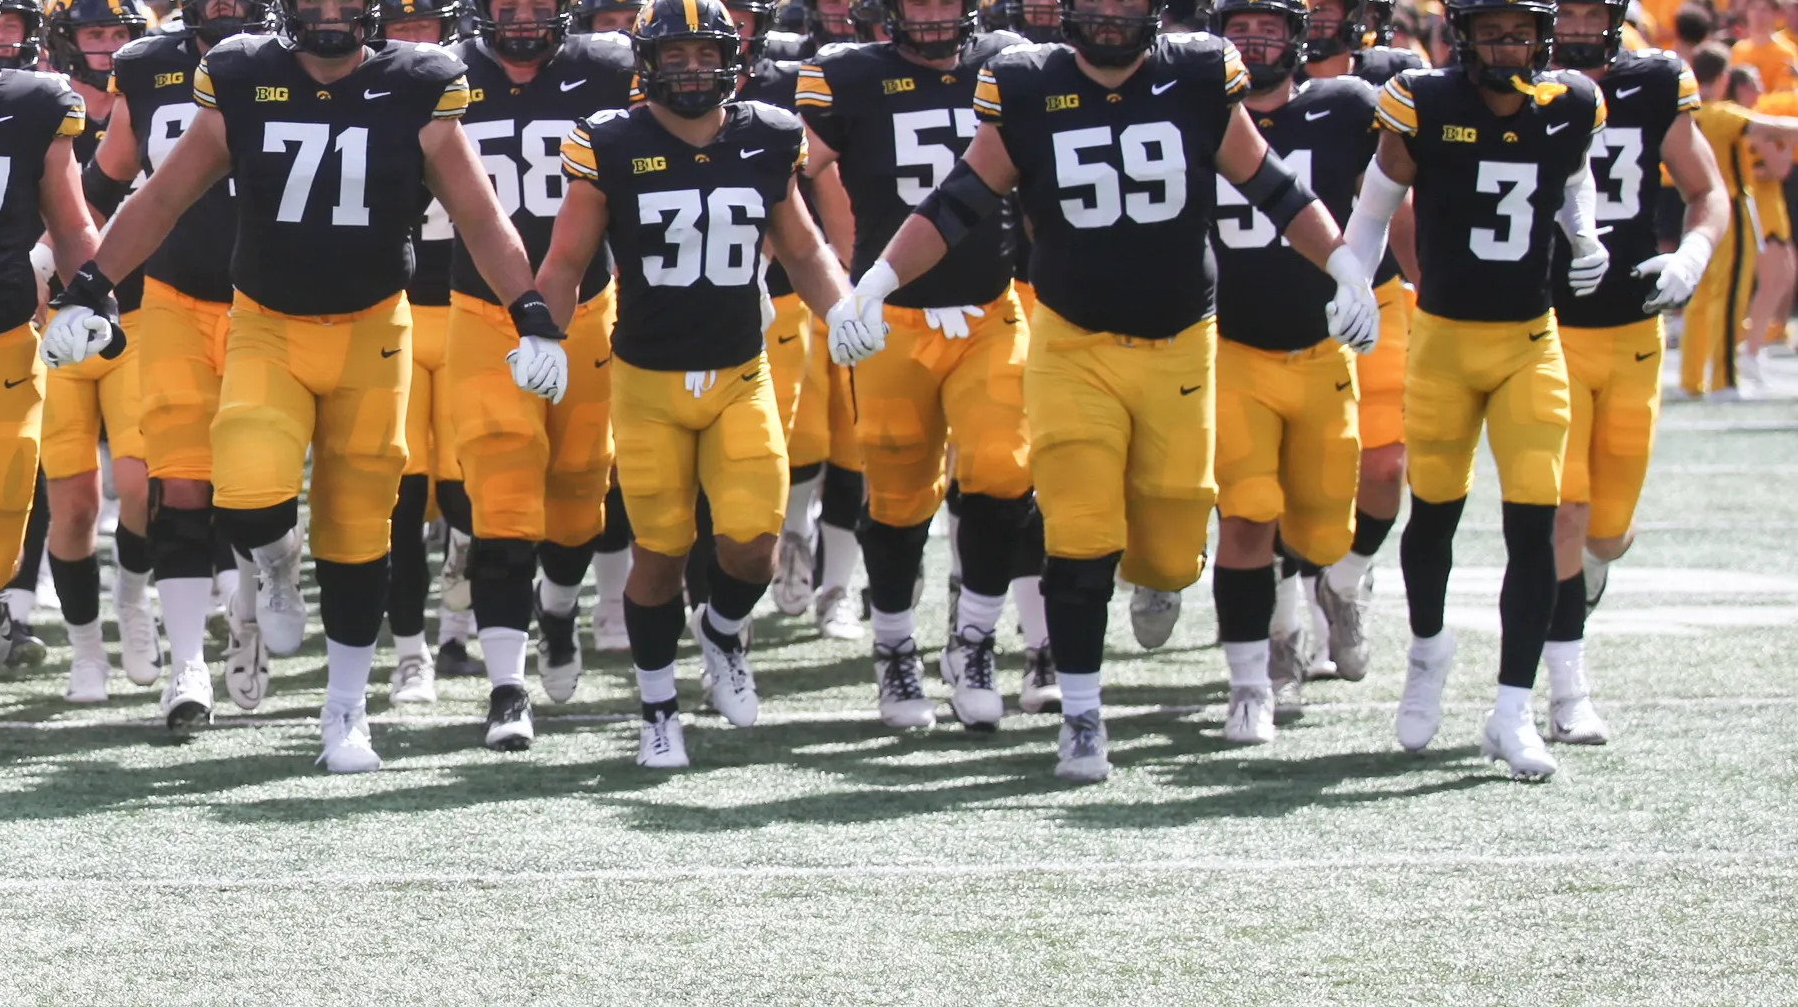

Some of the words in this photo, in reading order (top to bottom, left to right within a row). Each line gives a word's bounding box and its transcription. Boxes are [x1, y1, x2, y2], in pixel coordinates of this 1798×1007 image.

[263, 122, 370, 226] 71
[1052, 121, 1187, 229] 59
[1469, 161, 1538, 262] 3
[638, 187, 765, 287] 36
